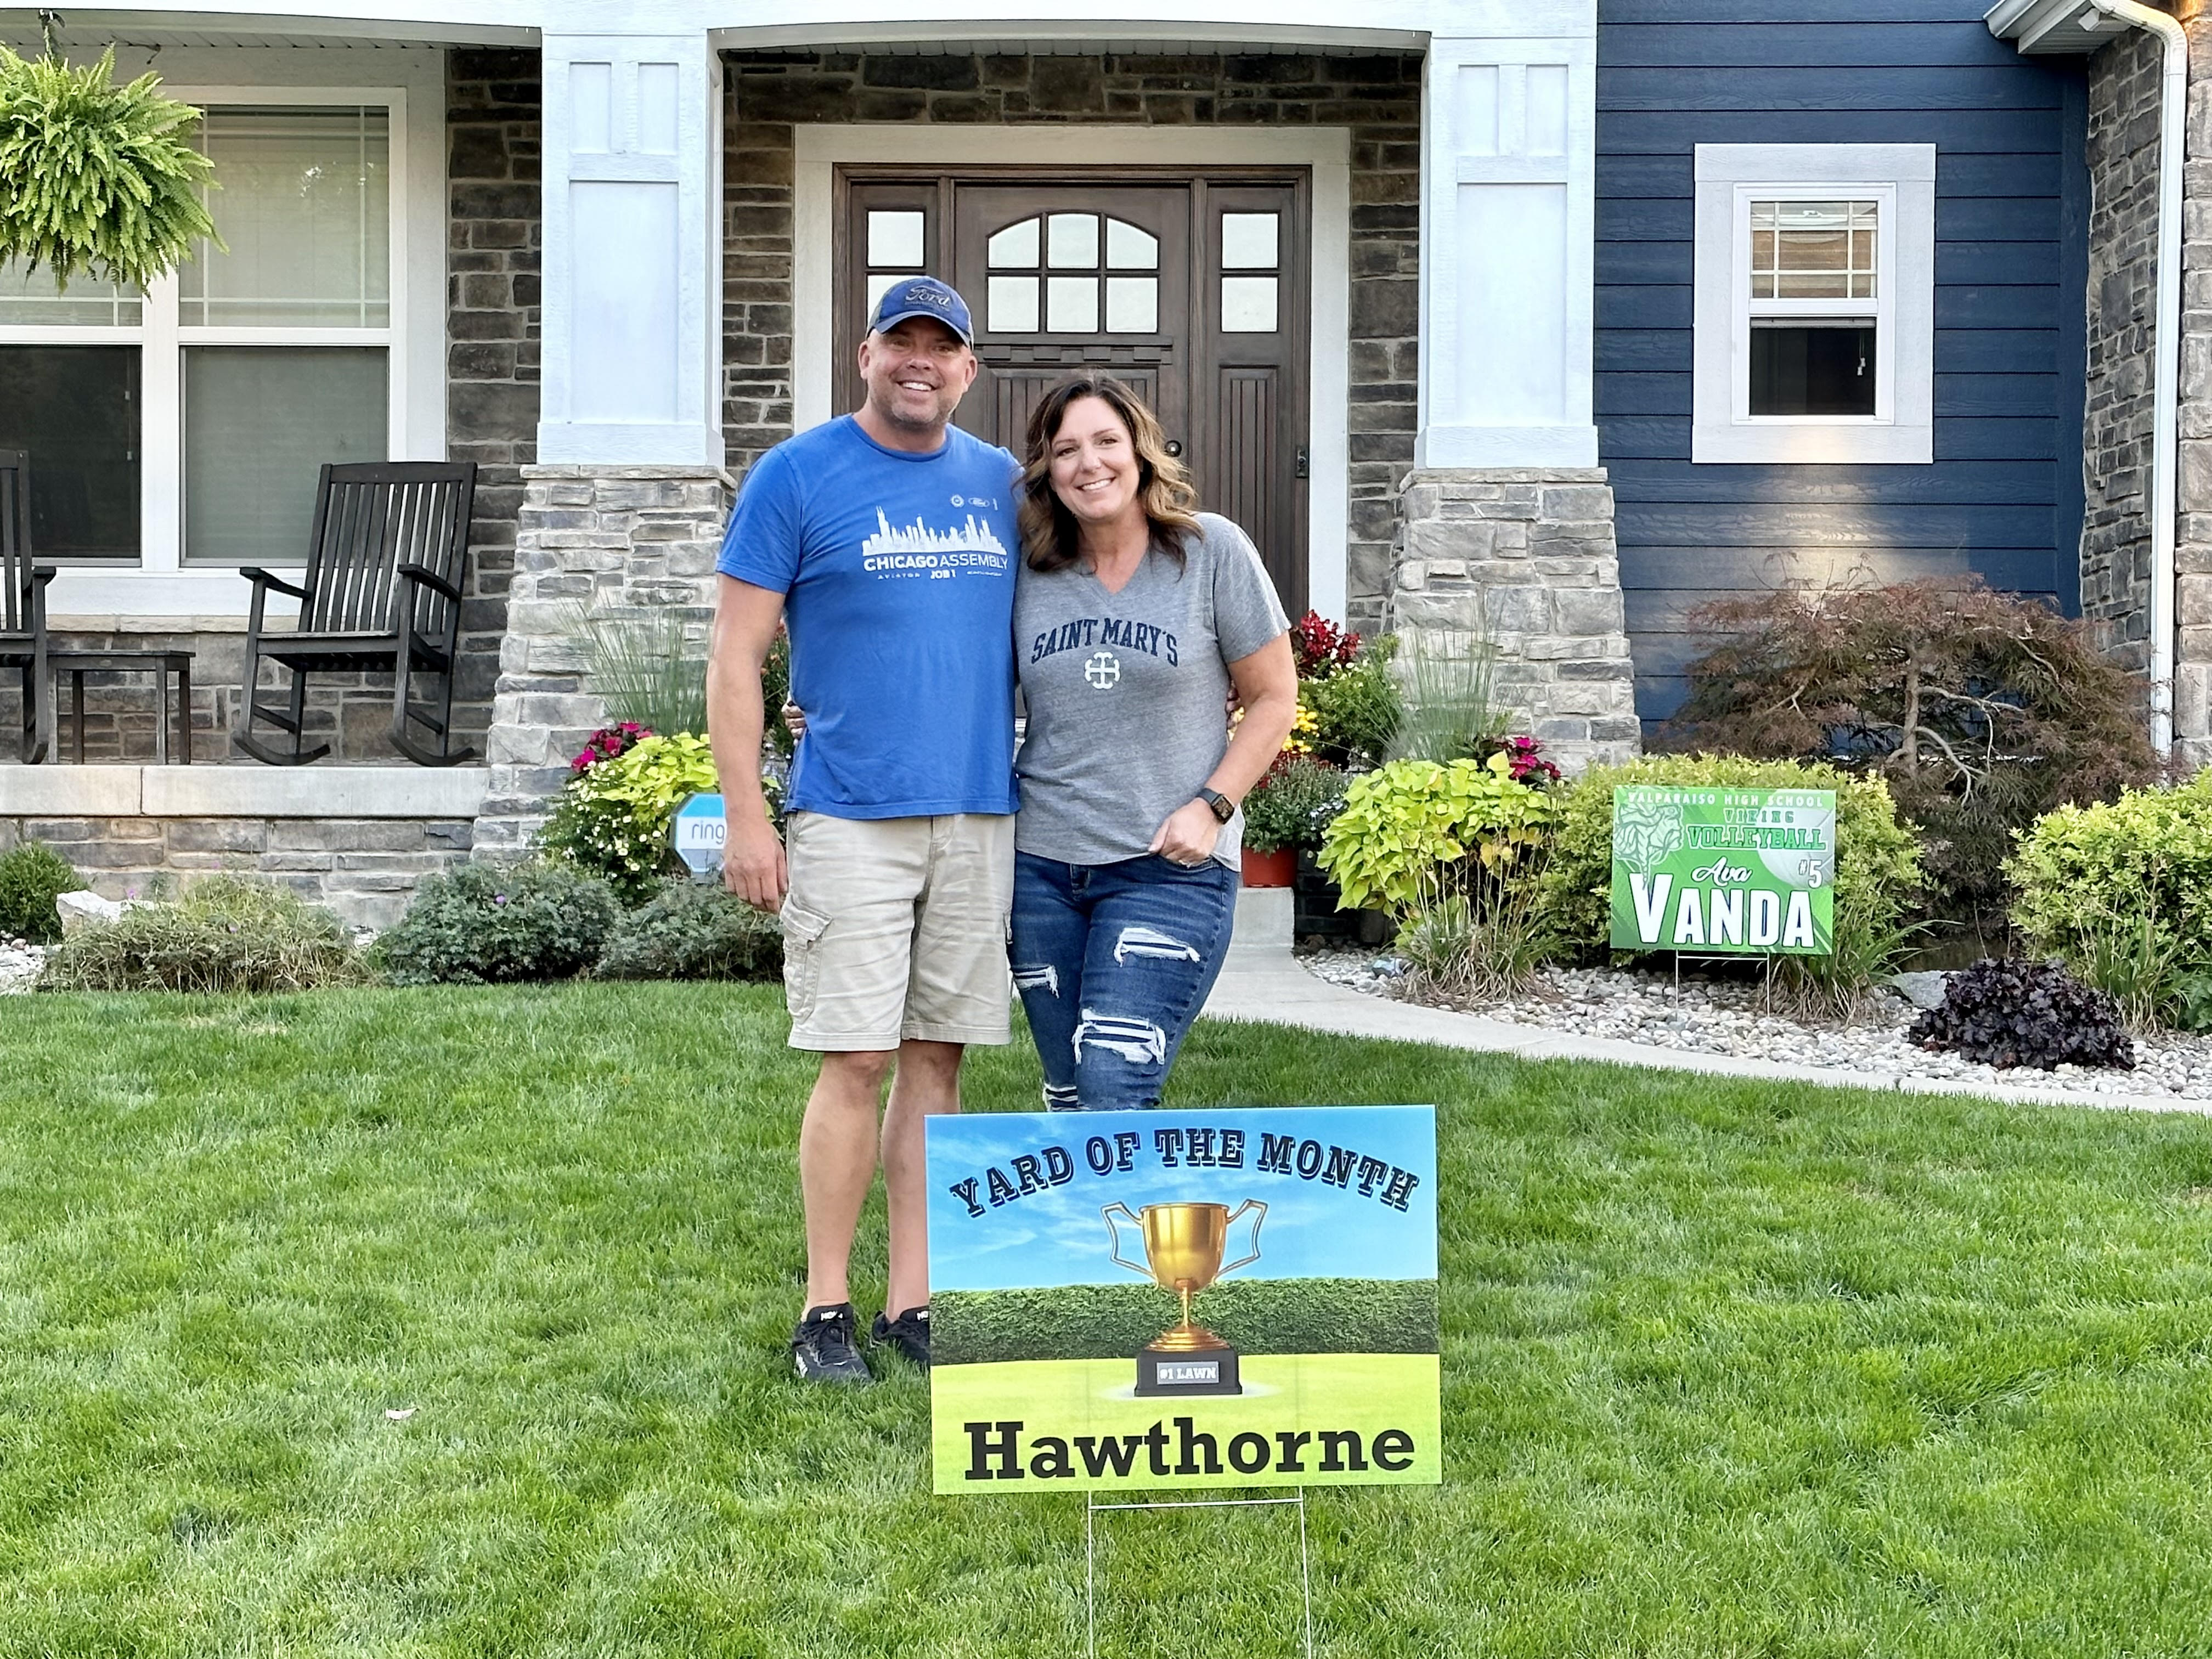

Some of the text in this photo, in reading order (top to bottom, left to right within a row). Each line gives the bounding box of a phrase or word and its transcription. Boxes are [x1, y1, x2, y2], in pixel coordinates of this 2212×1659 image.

[906, 285, 950, 307] Ford
[864, 554, 1008, 572] CHICAGO ASSEMBLY
[930, 569, 950, 579] JOB
[951, 569, 956, 578] 1
[1031, 618, 1178, 668] SAINT MARY'S
[1628, 792, 1823, 808] VALPARAISO HIGH SCHOOL
[1724, 808, 1795, 823] VIKING
[691, 820, 725, 845] ring
[1688, 826, 1826, 850] VOLLEYBALL
[1691, 856, 1752, 887] Ava
[1799, 859, 1823, 889] #5
[1628, 873, 1815, 947] VANDA
[949, 1128, 1420, 1218] YARD OF THE MONTH
[1176, 1367, 1216, 1379] LAWN
[964, 1417, 1414, 1480] Hawthorne
